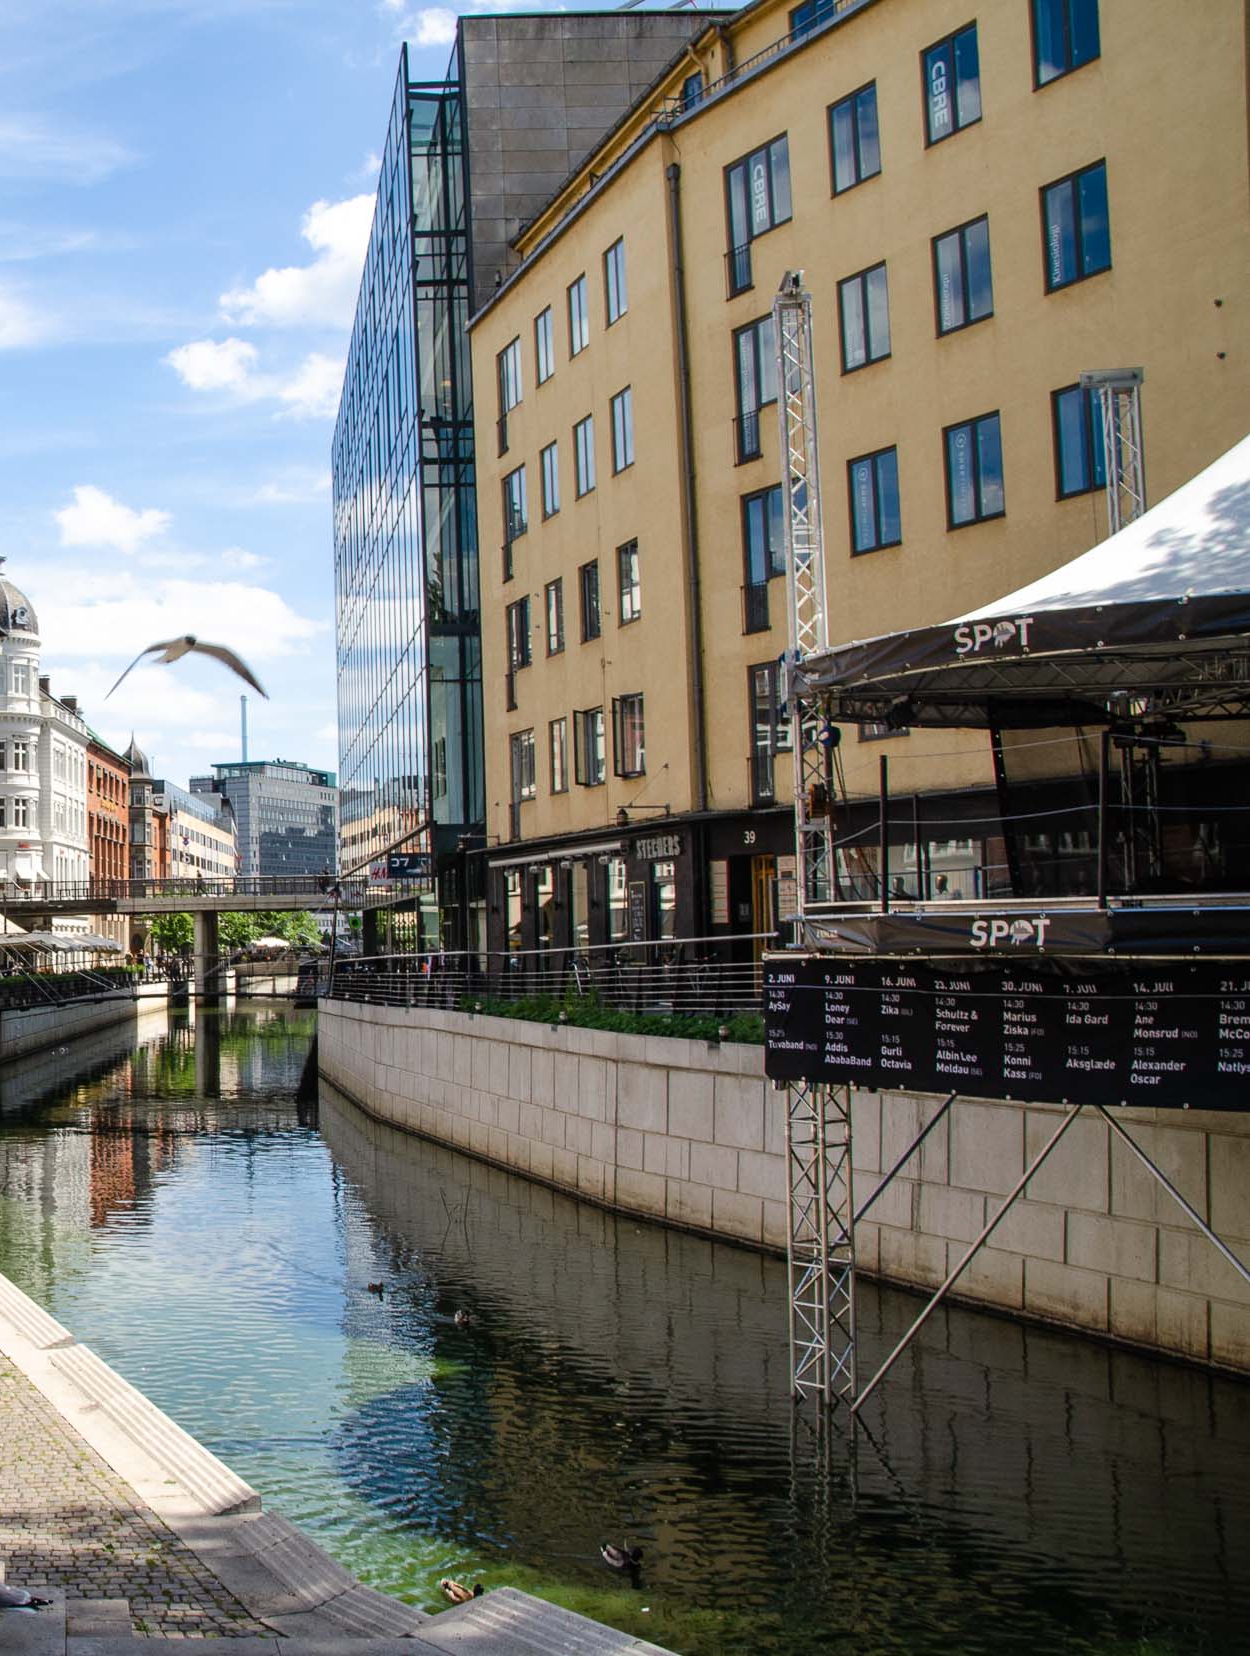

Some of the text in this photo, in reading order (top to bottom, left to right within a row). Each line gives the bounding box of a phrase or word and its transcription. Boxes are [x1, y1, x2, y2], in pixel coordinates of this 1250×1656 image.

[932, 61, 948, 128] CBRE
[753, 164, 767, 223] CBRE
[954, 618, 1034, 653] SPOT
[744, 831, 756, 844] 39
[970, 919, 1050, 947] SPOT
[769, 974, 794, 983] 2. JUNI
[825, 975, 854, 984] 9. JUNI
[882, 977, 916, 986] 16. JUNI
[949, 982, 970, 990] JUNI
[1002, 981, 1043, 992] 30. JUNI
[1063, 985, 1097, 993] 7. JULI
[1134, 982, 1173, 992] 14. JULI
[1221, 981, 1237, 991] 21.
[825, 992, 843, 1000] 14:30
[882, 994, 900, 1002] 14:30
[769, 1001, 790, 1011] AySay
[935, 998, 955, 1006] 14:30
[1003, 1000, 1024, 1008] 14:30
[1068, 1002, 1089, 1011] 14:30
[1135, 1002, 1157, 1010] 14:30
[1221, 1001, 1245, 1010] 14:30
[825, 1003, 850, 1014] Loney
[881, 1005, 899, 1015] Zika
[936, 1008, 978, 1020] Schultz &
[1003, 1012, 1036, 1022] Marius
[1066, 1014, 1108, 1024] Ida Gard
[825, 1015, 845, 1024] Dear
[1135, 1015, 1154, 1024] Ane
[936, 1021, 970, 1032] Forever
[1004, 1025, 1028, 1035] Ziska
[826, 1032, 843, 1040] 15:30
[1134, 1028, 1178, 1038] Monsrud
[769, 1040, 803, 1049] Tuvaband
[882, 1035, 900, 1044] 15:15
[937, 1038, 955, 1047] 15:15
[825, 1042, 848, 1052] Addis
[881, 1046, 902, 1056] Gurli
[1005, 1043, 1025, 1052] 15:25
[1068, 1046, 1089, 1055] 15:15
[1134, 1047, 1155, 1056] 15:15
[936, 1050, 958, 1060] Albin
[1220, 1048, 1243, 1058] 15:25
[825, 1055, 871, 1066] AbabaBand
[881, 1058, 911, 1069] Octavia
[1004, 1055, 1031, 1065] Konni
[1066, 1058, 1115, 1070] Aksglæde
[936, 1063, 969, 1074] Meldau
[1132, 1060, 1186, 1071] Alexander
[1004, 1068, 1026, 1079] Kass
[1131, 1074, 1161, 1084] Oscar
